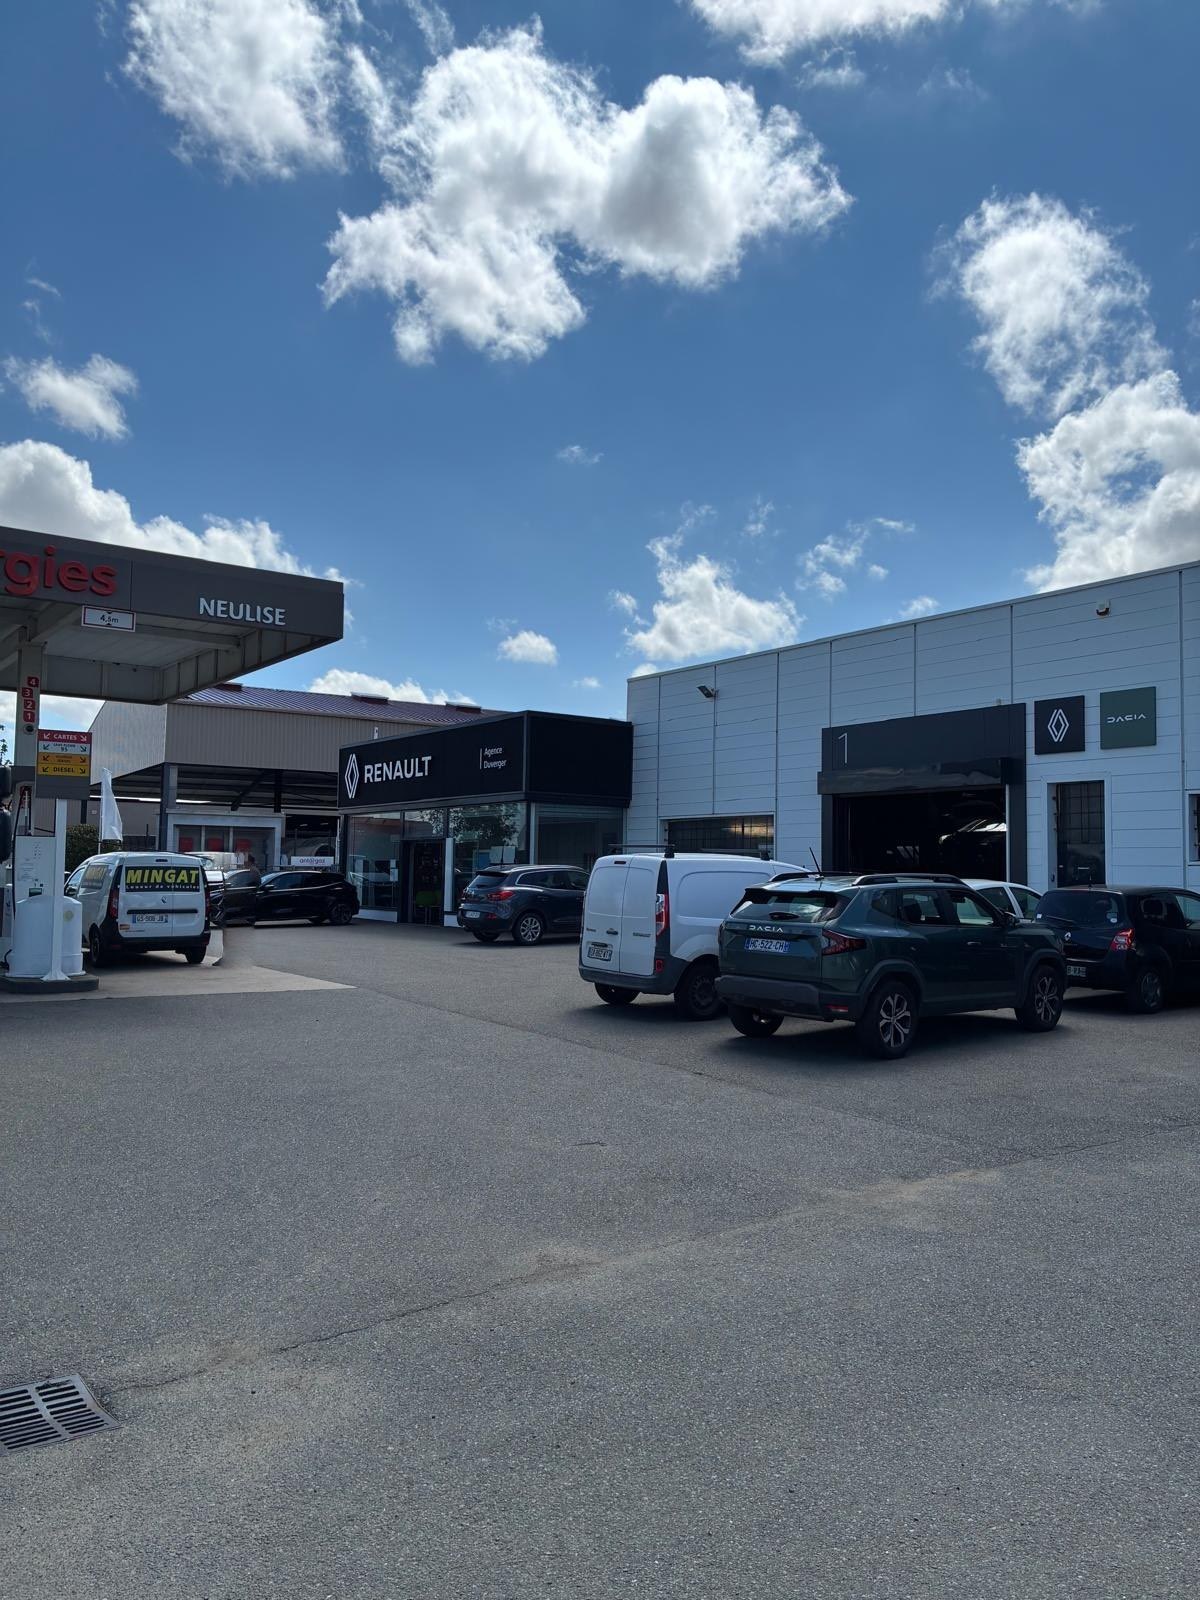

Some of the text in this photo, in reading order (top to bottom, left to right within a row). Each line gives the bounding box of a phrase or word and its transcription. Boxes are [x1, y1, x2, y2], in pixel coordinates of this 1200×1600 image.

[0, 545, 117, 596] gies
[199, 597, 286, 626] NEULISE
[1107, 713, 1147, 723] DACIA
[53, 733, 78, 741] CARTES
[484, 747, 503, 757] Agence
[837, 733, 849, 764] 1
[364, 755, 432, 784] RENAULT
[126, 869, 199, 884] MINGAT
[749, 924, 783, 932] DACIA
